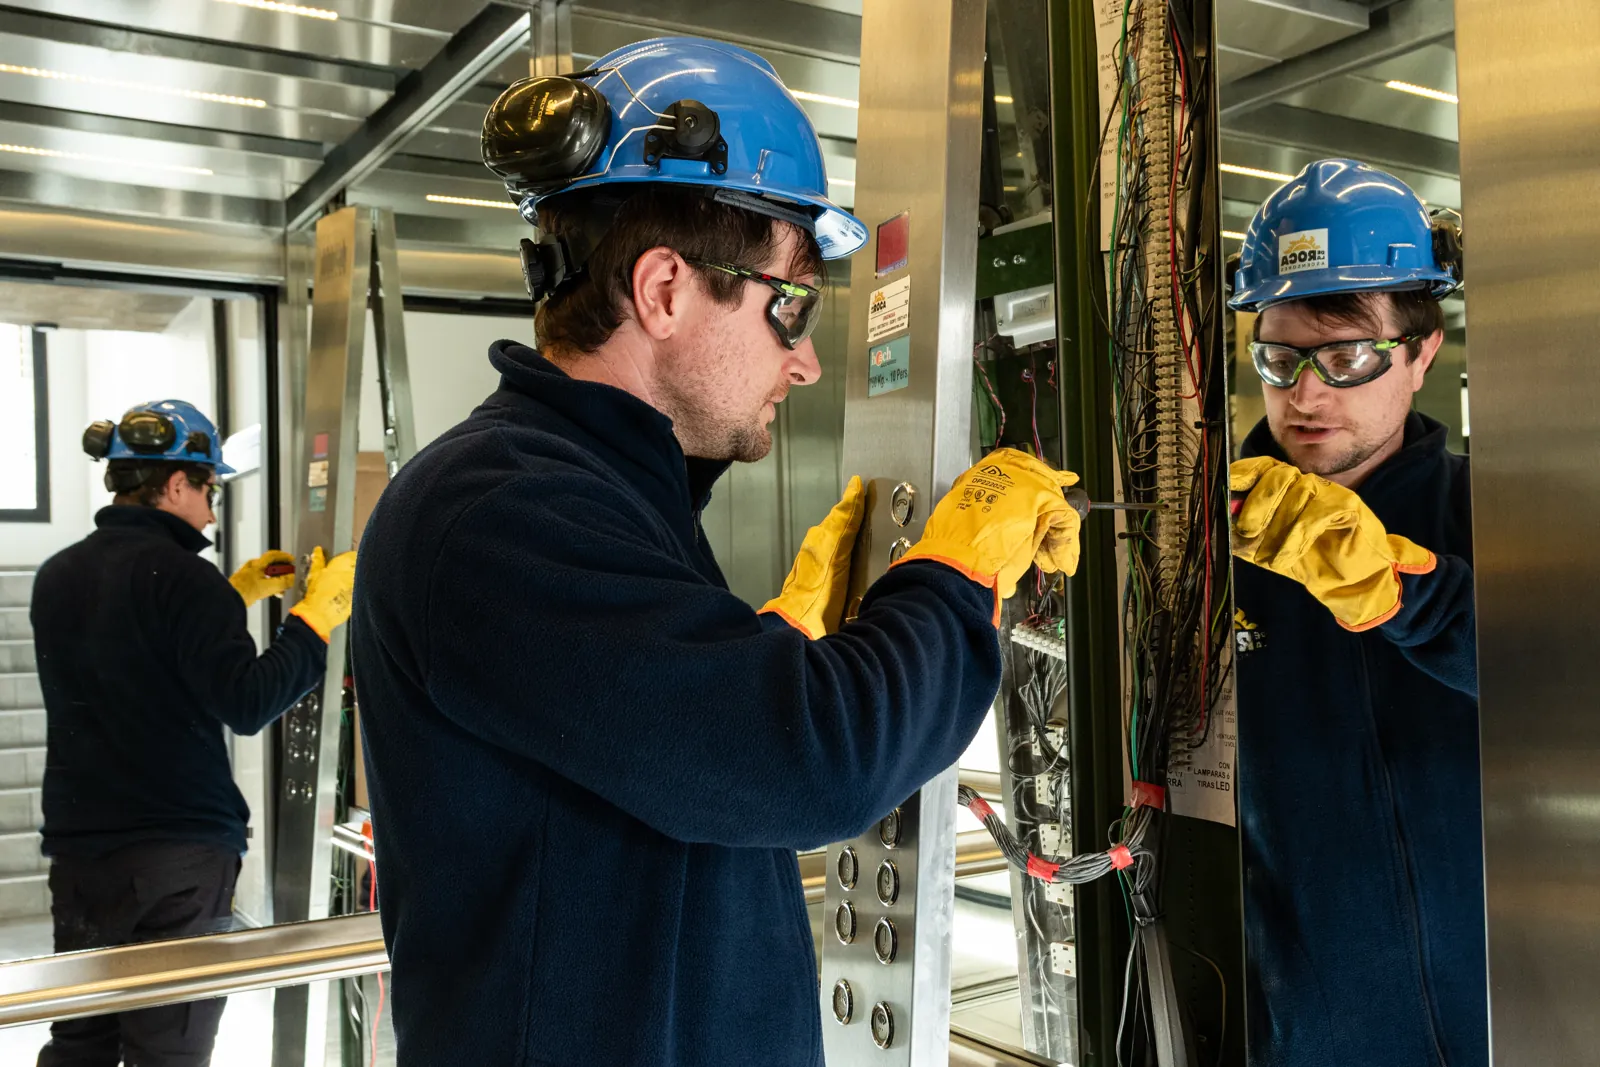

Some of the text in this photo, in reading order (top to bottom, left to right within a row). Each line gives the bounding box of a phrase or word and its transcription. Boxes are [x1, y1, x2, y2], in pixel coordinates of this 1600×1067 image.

[538, 92, 550, 124] PELTOR
[545, 100, 557, 115] 3M
[1219, 761, 1230, 769] CON
[1193, 768, 1226, 778] LAMPARAS
[1197, 780, 1230, 792] TIRAS LED
